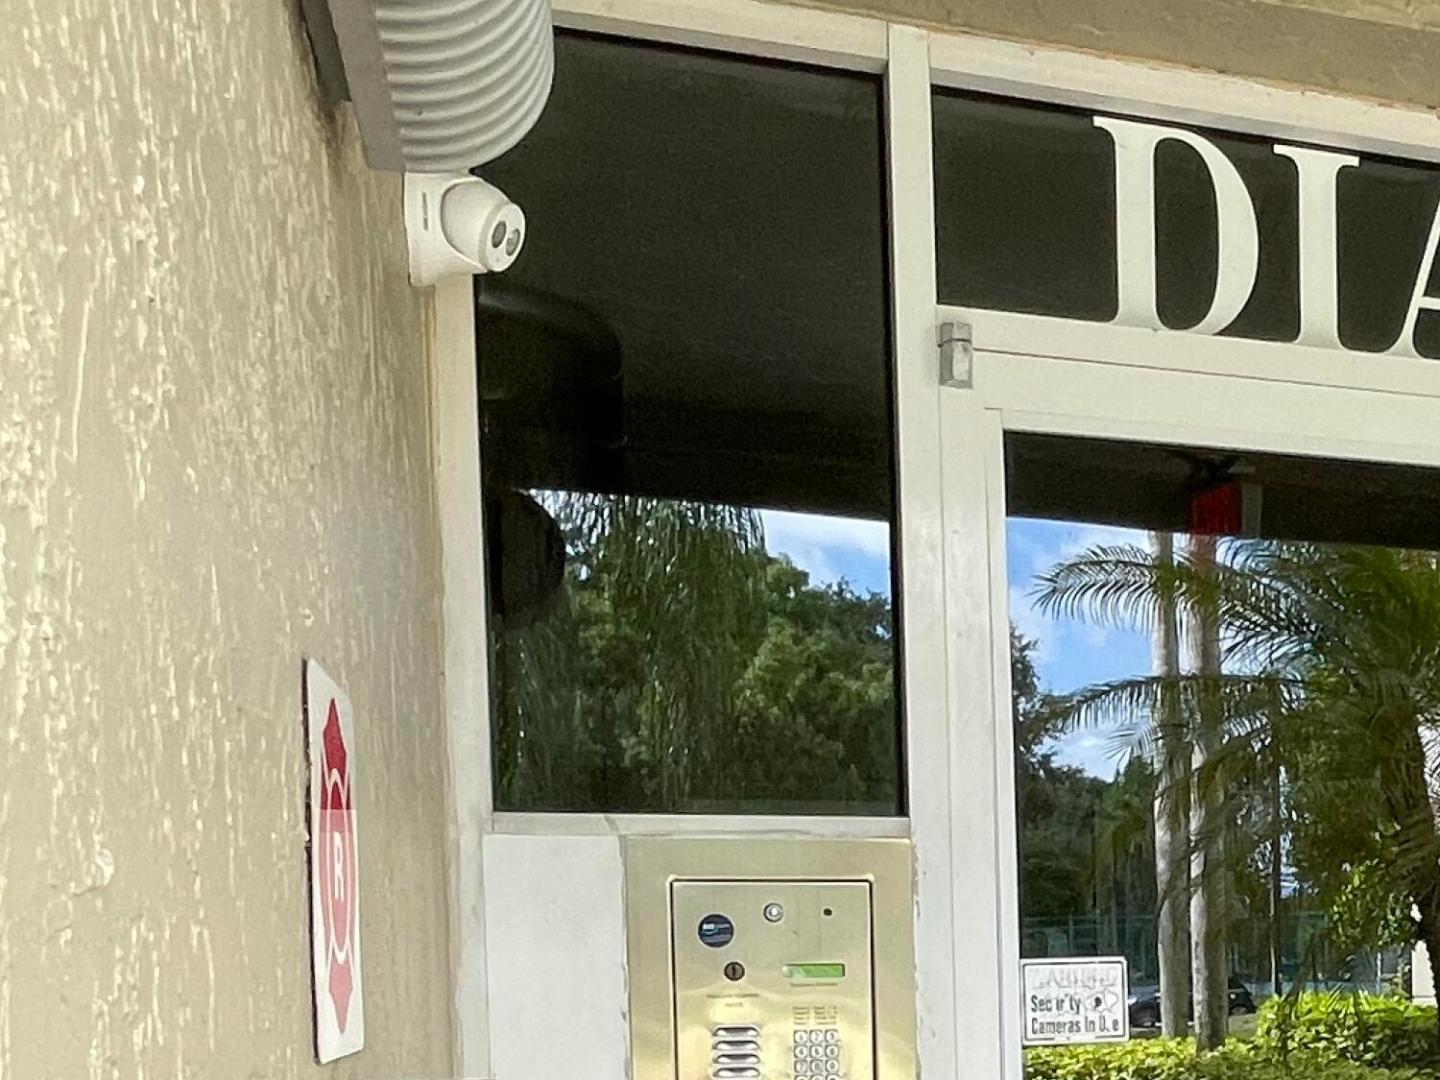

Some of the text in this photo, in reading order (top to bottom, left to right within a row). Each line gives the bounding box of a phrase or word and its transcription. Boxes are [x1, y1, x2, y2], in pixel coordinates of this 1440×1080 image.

[1031, 994, 1081, 1015] Secrty
[1031, 1017, 1081, 1035] Cameras
[1085, 1015, 1096, 1033] In
